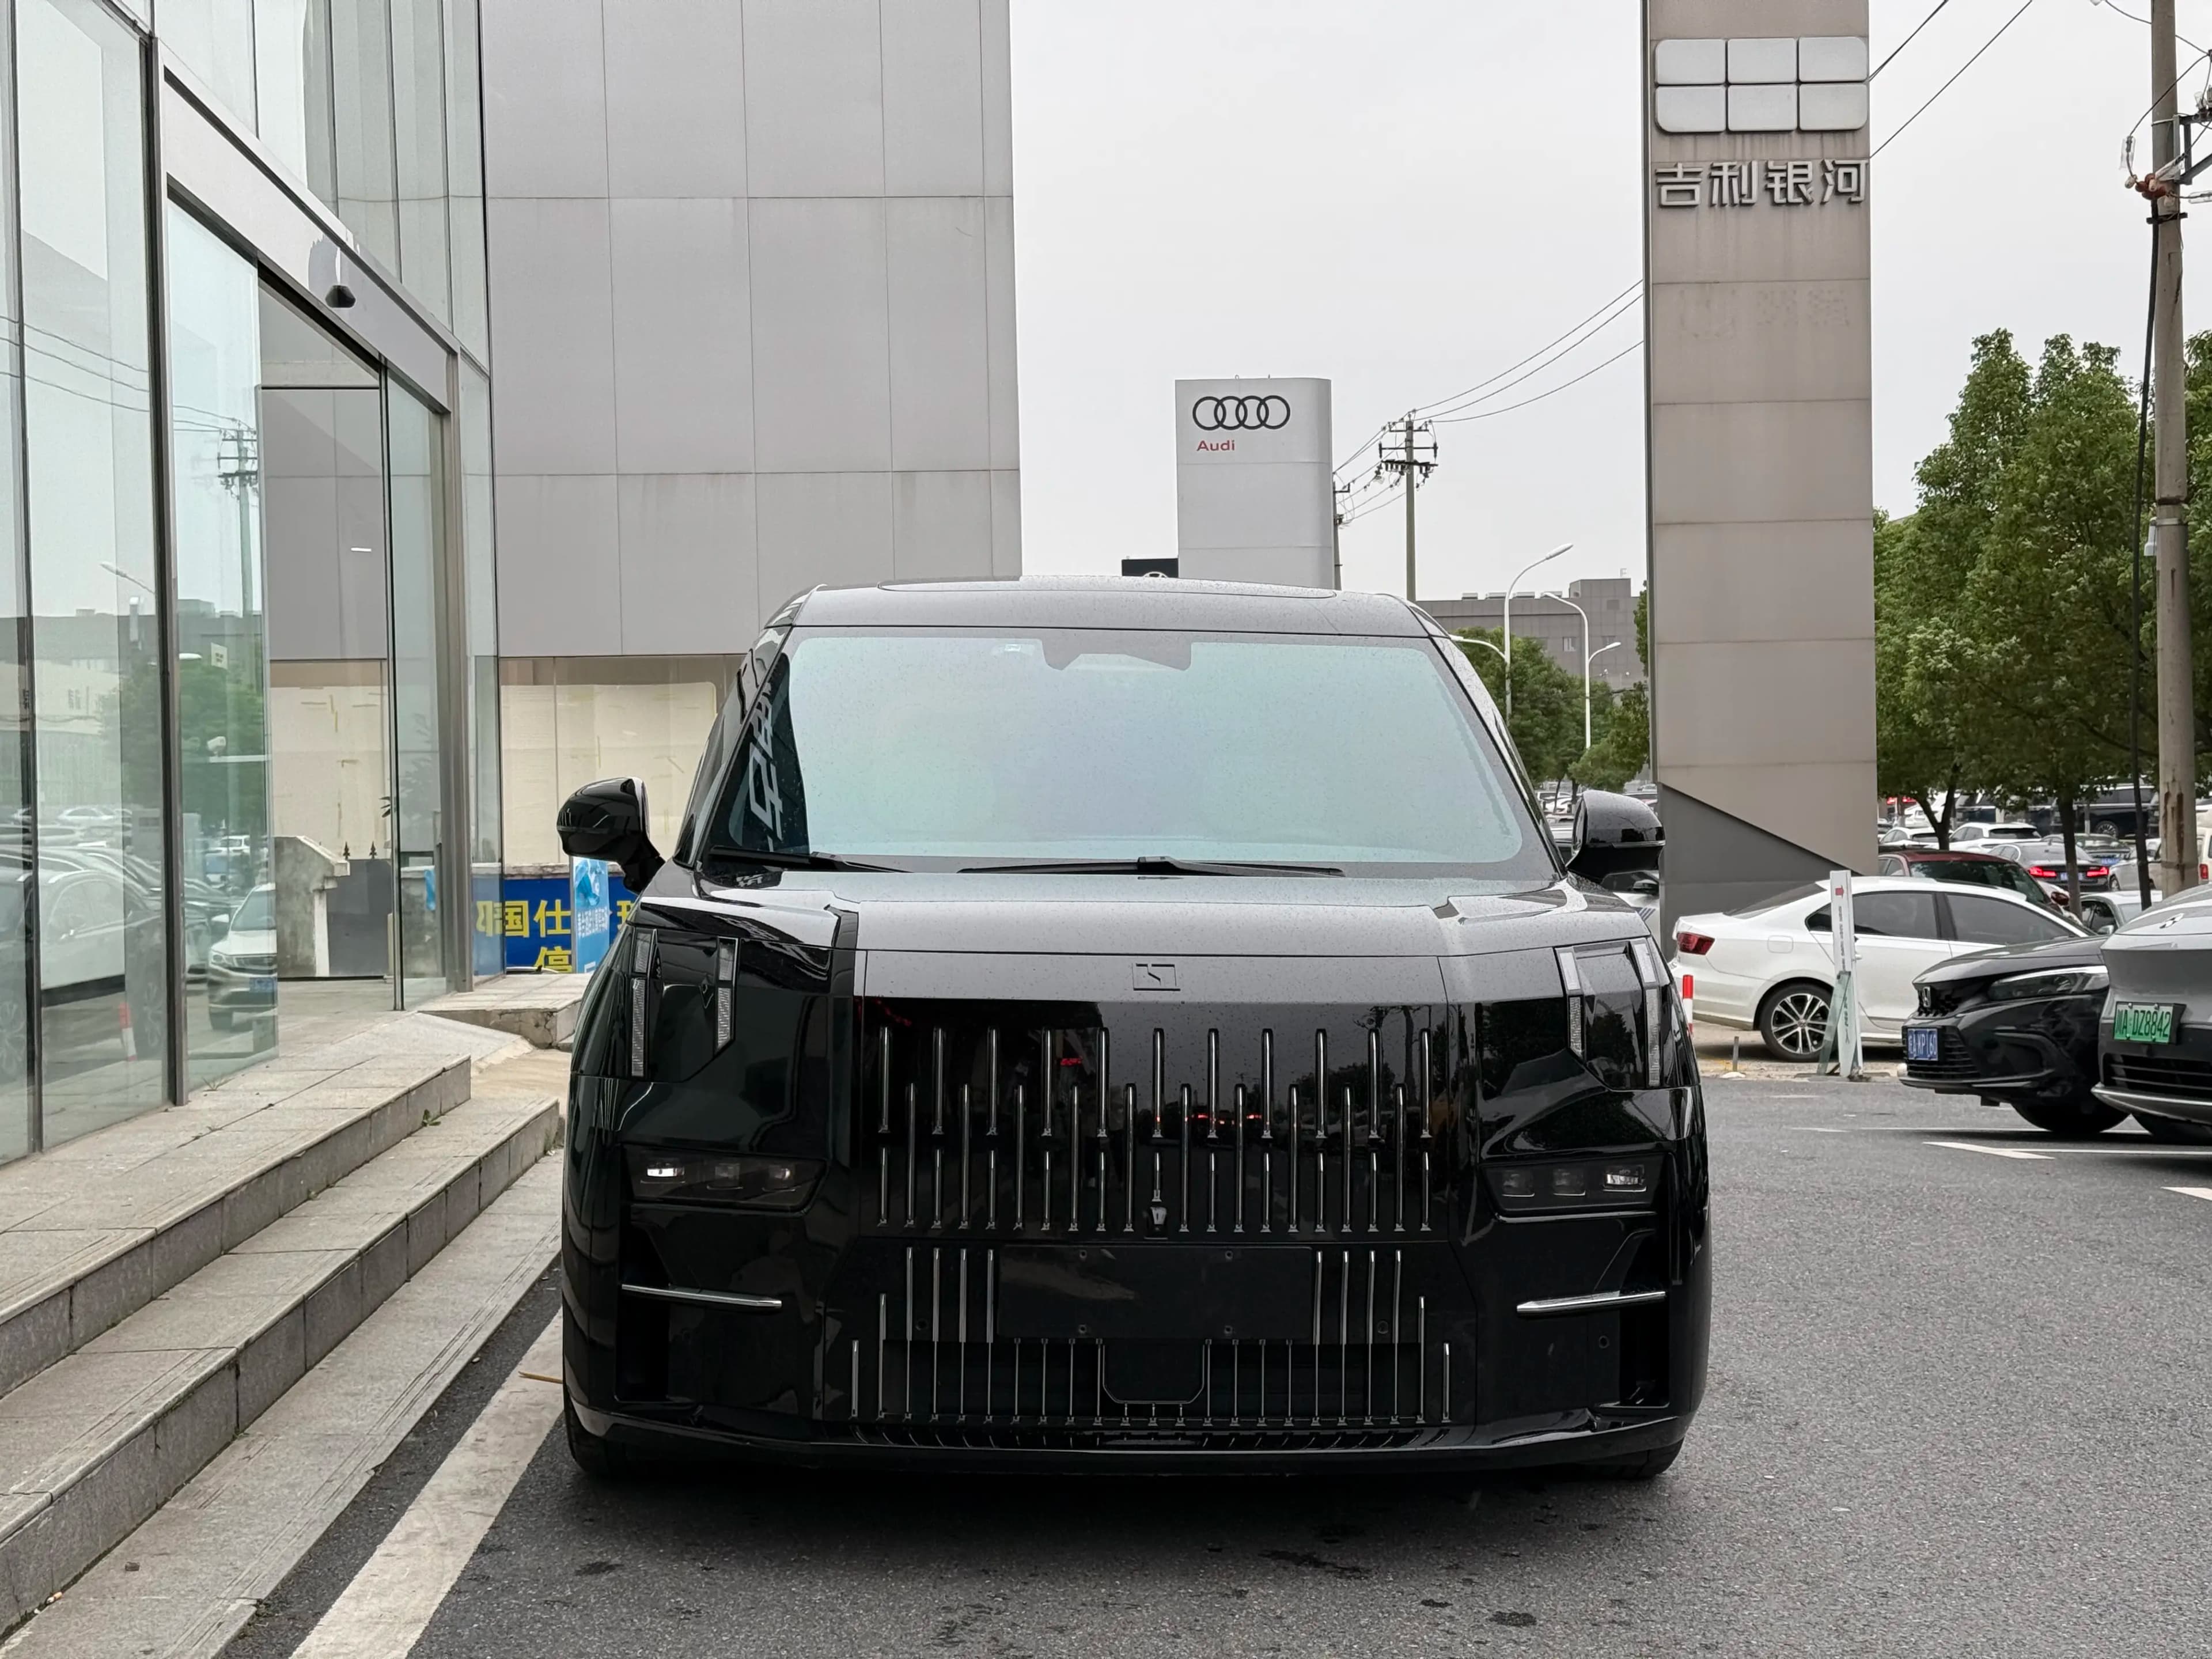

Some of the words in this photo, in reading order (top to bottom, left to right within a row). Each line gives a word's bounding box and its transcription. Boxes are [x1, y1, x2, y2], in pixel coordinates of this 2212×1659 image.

[1655, 158, 1869, 207] 吉利银河
[1196, 440, 1235, 452] Audi
